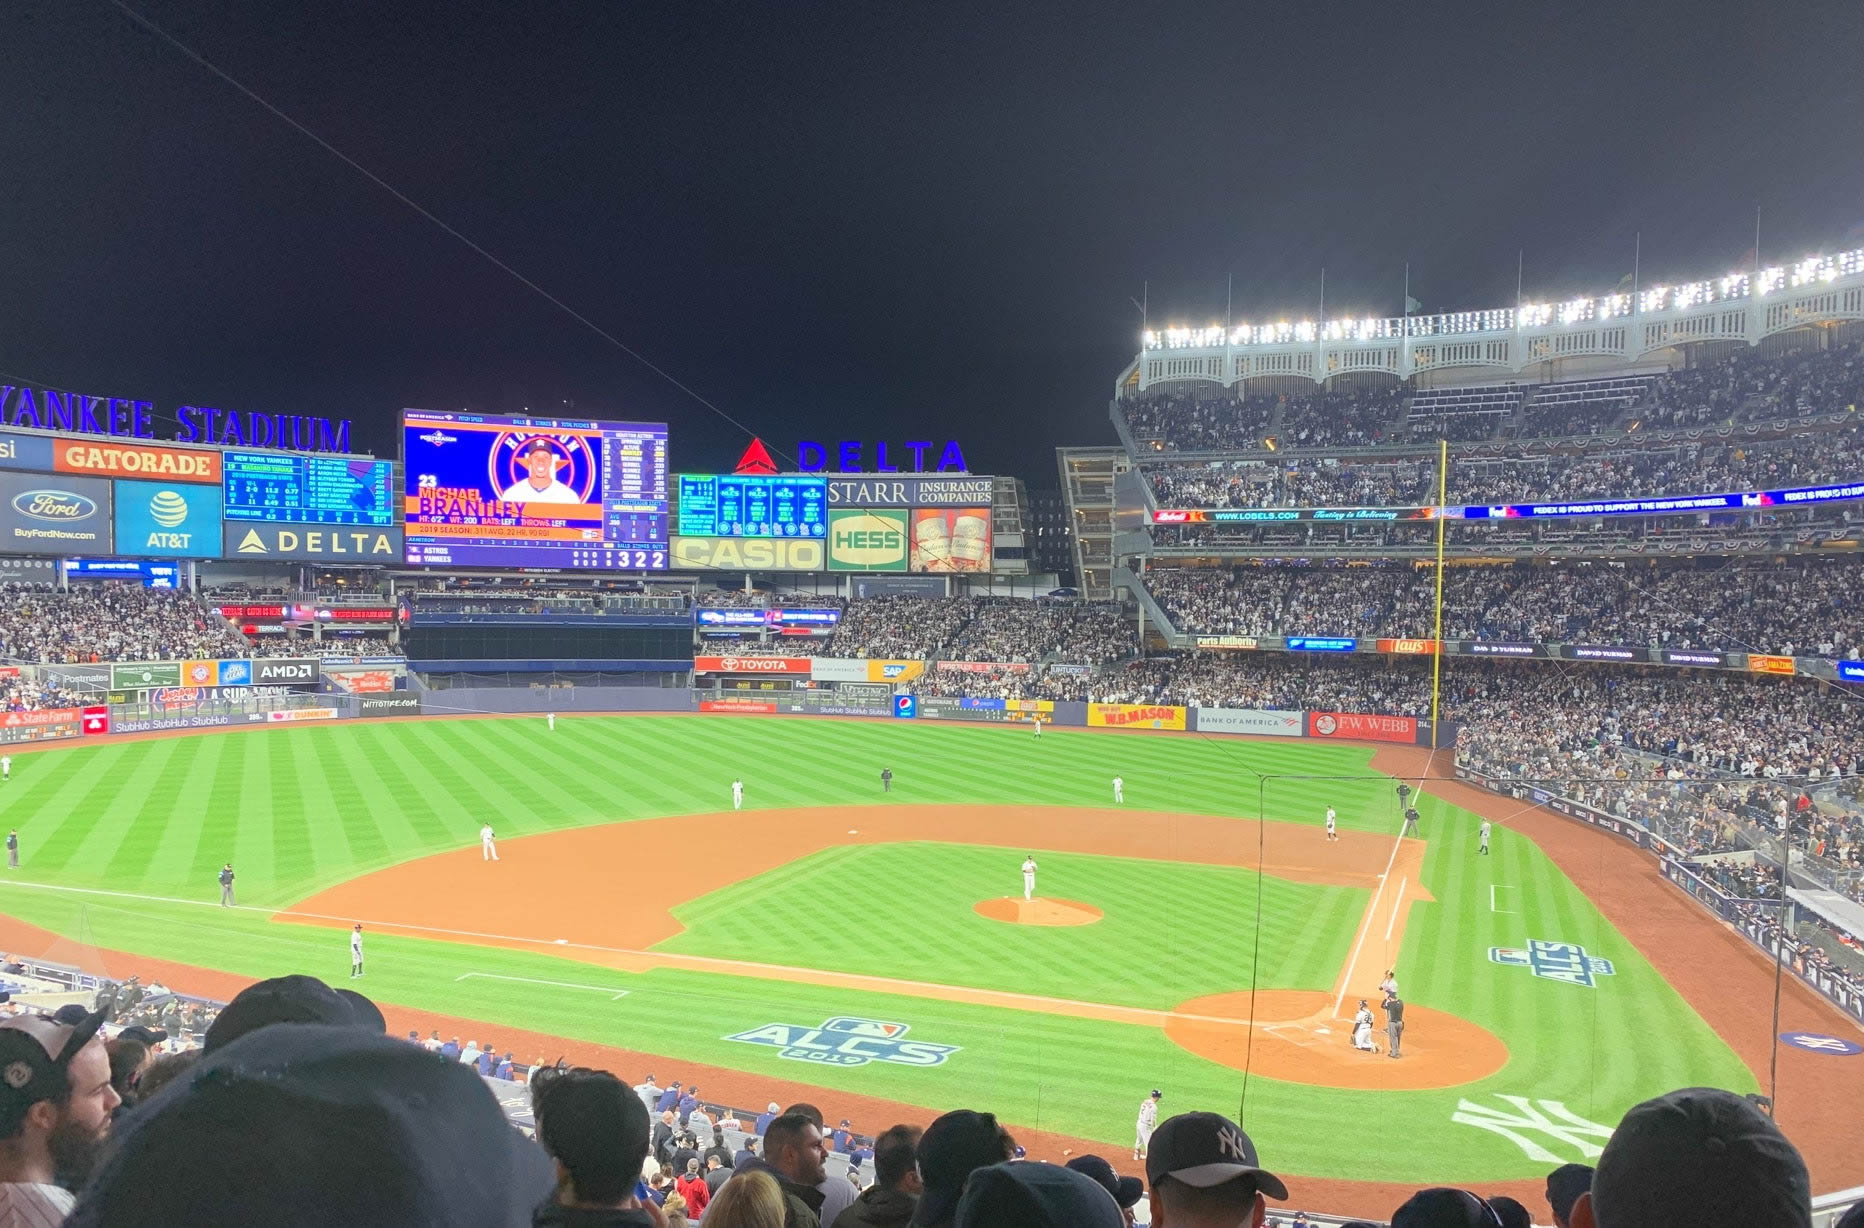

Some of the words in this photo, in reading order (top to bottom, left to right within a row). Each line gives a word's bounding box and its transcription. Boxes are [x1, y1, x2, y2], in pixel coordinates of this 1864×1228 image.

[176, 405, 351, 454] STADIUM
[65, 446, 211, 475] GATORADE
[266, 457, 293, 465] YANKEES
[798, 440, 967, 473] DELTA
[418, 474, 437, 487] 23
[920, 481, 992, 492] INSURANCE
[419, 487, 482, 500] MICHAEL
[829, 482, 909, 503] STARR
[919, 492, 992, 503] COMPANIES
[29, 493, 80, 517] Ford
[420, 498, 527, 518] BRANTLEY
[1534, 506, 1557, 514] FEDEX
[1568, 505, 1593, 513] PROUD
[1594, 504, 1603, 512] TO
[1605, 503, 1639, 512] SUPPORT
[1641, 502, 1655, 510] THE
[1656, 501, 1674, 509] NEW
[1675, 500, 1693, 508] YORK
[1784, 492, 1806, 501] FEDEX
[1807, 491, 1815, 499] IS
[1215, 512, 1299, 520] WWW.LOBELS.COM
[1313, 511, 1345, 520] Tasting
[1356, 510, 1398, 520] Believing
[420, 525, 438, 533] 2019
[501, 518, 516, 526] LEFT
[552, 519, 566, 527] LEFT
[15, 528, 95, 540] BuyFordNow.com
[146, 532, 192, 549] AT&T
[836, 531, 899, 549] HESS
[279, 531, 392, 554] DELTA
[424, 555, 452, 563] YANKEES
[618, 551, 629, 567] 3
[635, 552, 646, 567] 2
[652, 552, 663, 567] 2
[676, 539, 821, 569] CASIO
[1197, 637, 1218, 646] Parts
[1219, 636, 1257, 646] Authority
[261, 665, 297, 678] AMD
[741, 660, 787, 670] TOYOTA
[883, 667, 901, 676] SAP
[64, 674, 109, 684] Postmates
[211, 688, 219, 704] A
[363, 699, 418, 710] NITTOTIRE.COM
[820, 706, 843, 714] StubHub
[23, 712, 48, 724] State
[49, 710, 72, 721] Farm
[295, 709, 332, 719] DUNKIN'
[116, 722, 150, 732] StubHub
[152, 719, 188, 729] StubHub
[191, 716, 228, 726] StubHub
[1239, 718, 1279, 726] AMERICA
[1339, 717, 1363, 730] F.W.
[1366, 717, 1409, 732] WEBB
[1418, 720, 1427, 728] 314
[1534, 942, 1588, 985] ALCS
[737, 1026, 951, 1064] ALCS
[787, 1050, 863, 1064] 2019
[1217, 1126, 1247, 1160] NY
